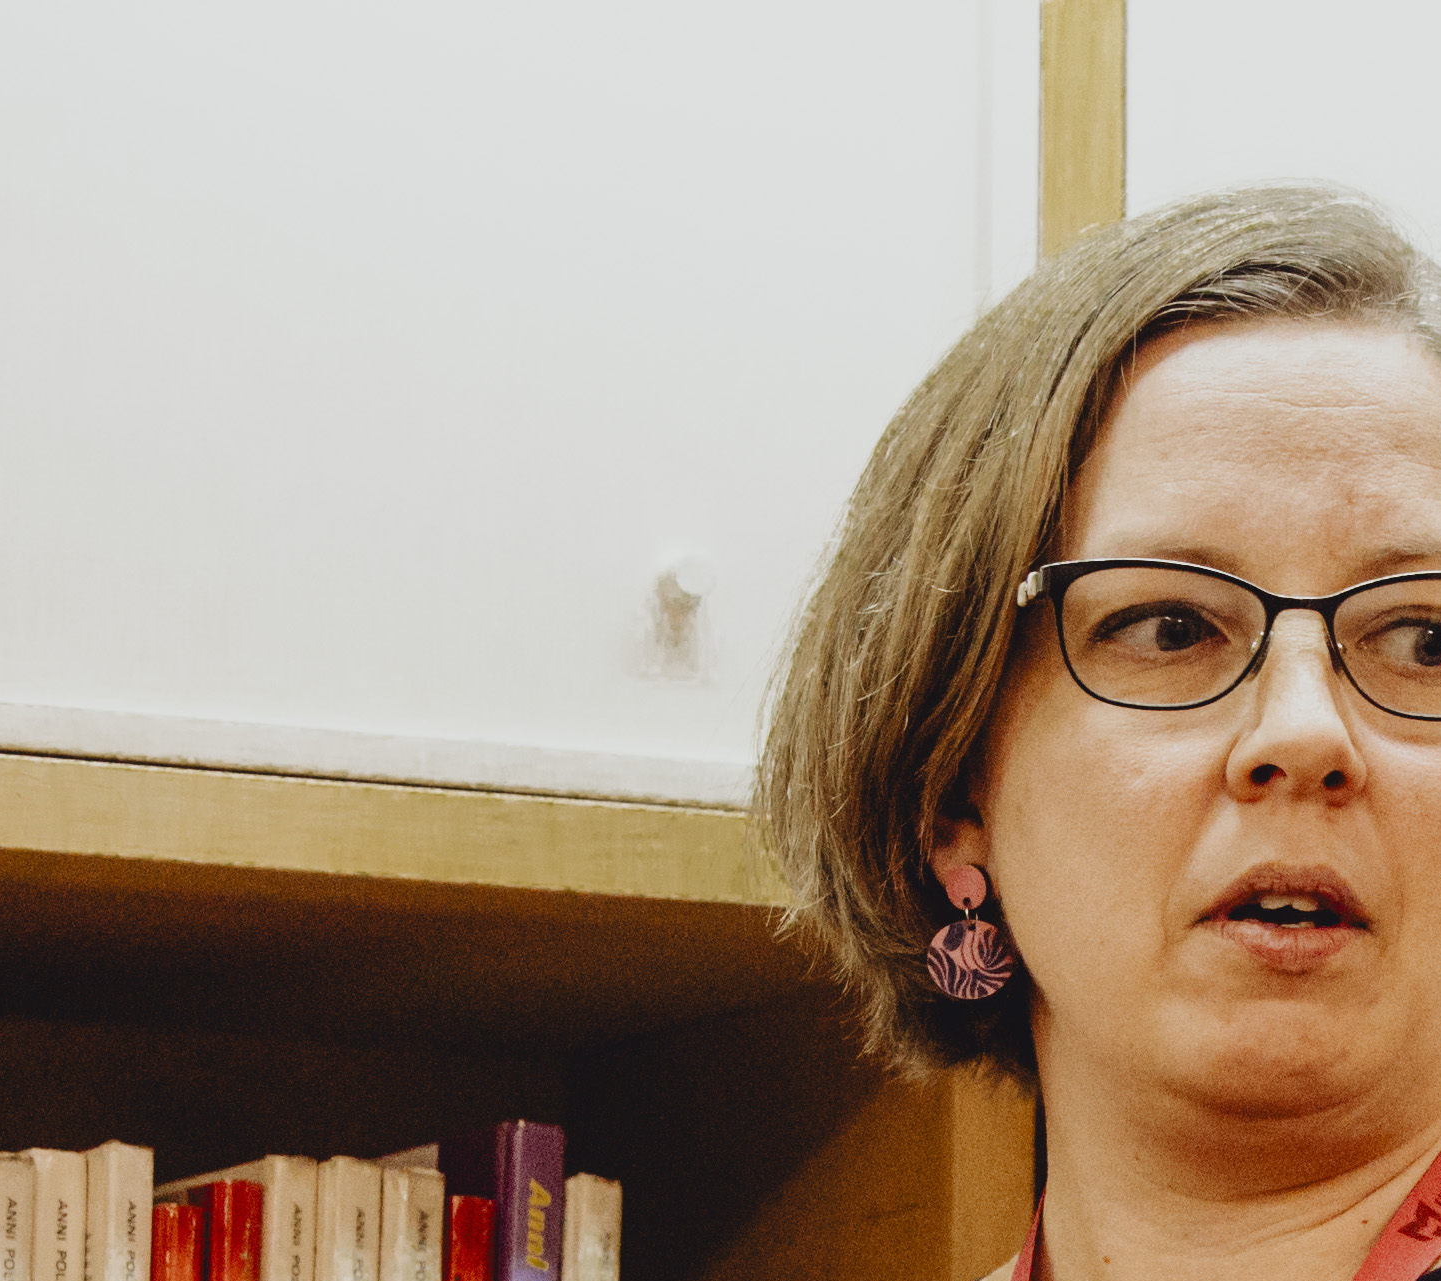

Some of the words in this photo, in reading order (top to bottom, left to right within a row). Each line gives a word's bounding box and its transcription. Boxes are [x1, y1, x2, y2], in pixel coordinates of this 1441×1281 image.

[4, 1197, 19, 1240] ANNI
[55, 1198, 69, 1242] ANNI
[124, 1199, 137, 1243] ANNI
[291, 1202, 304, 1248] ANNI
[524, 1178, 553, 1270] Anni
